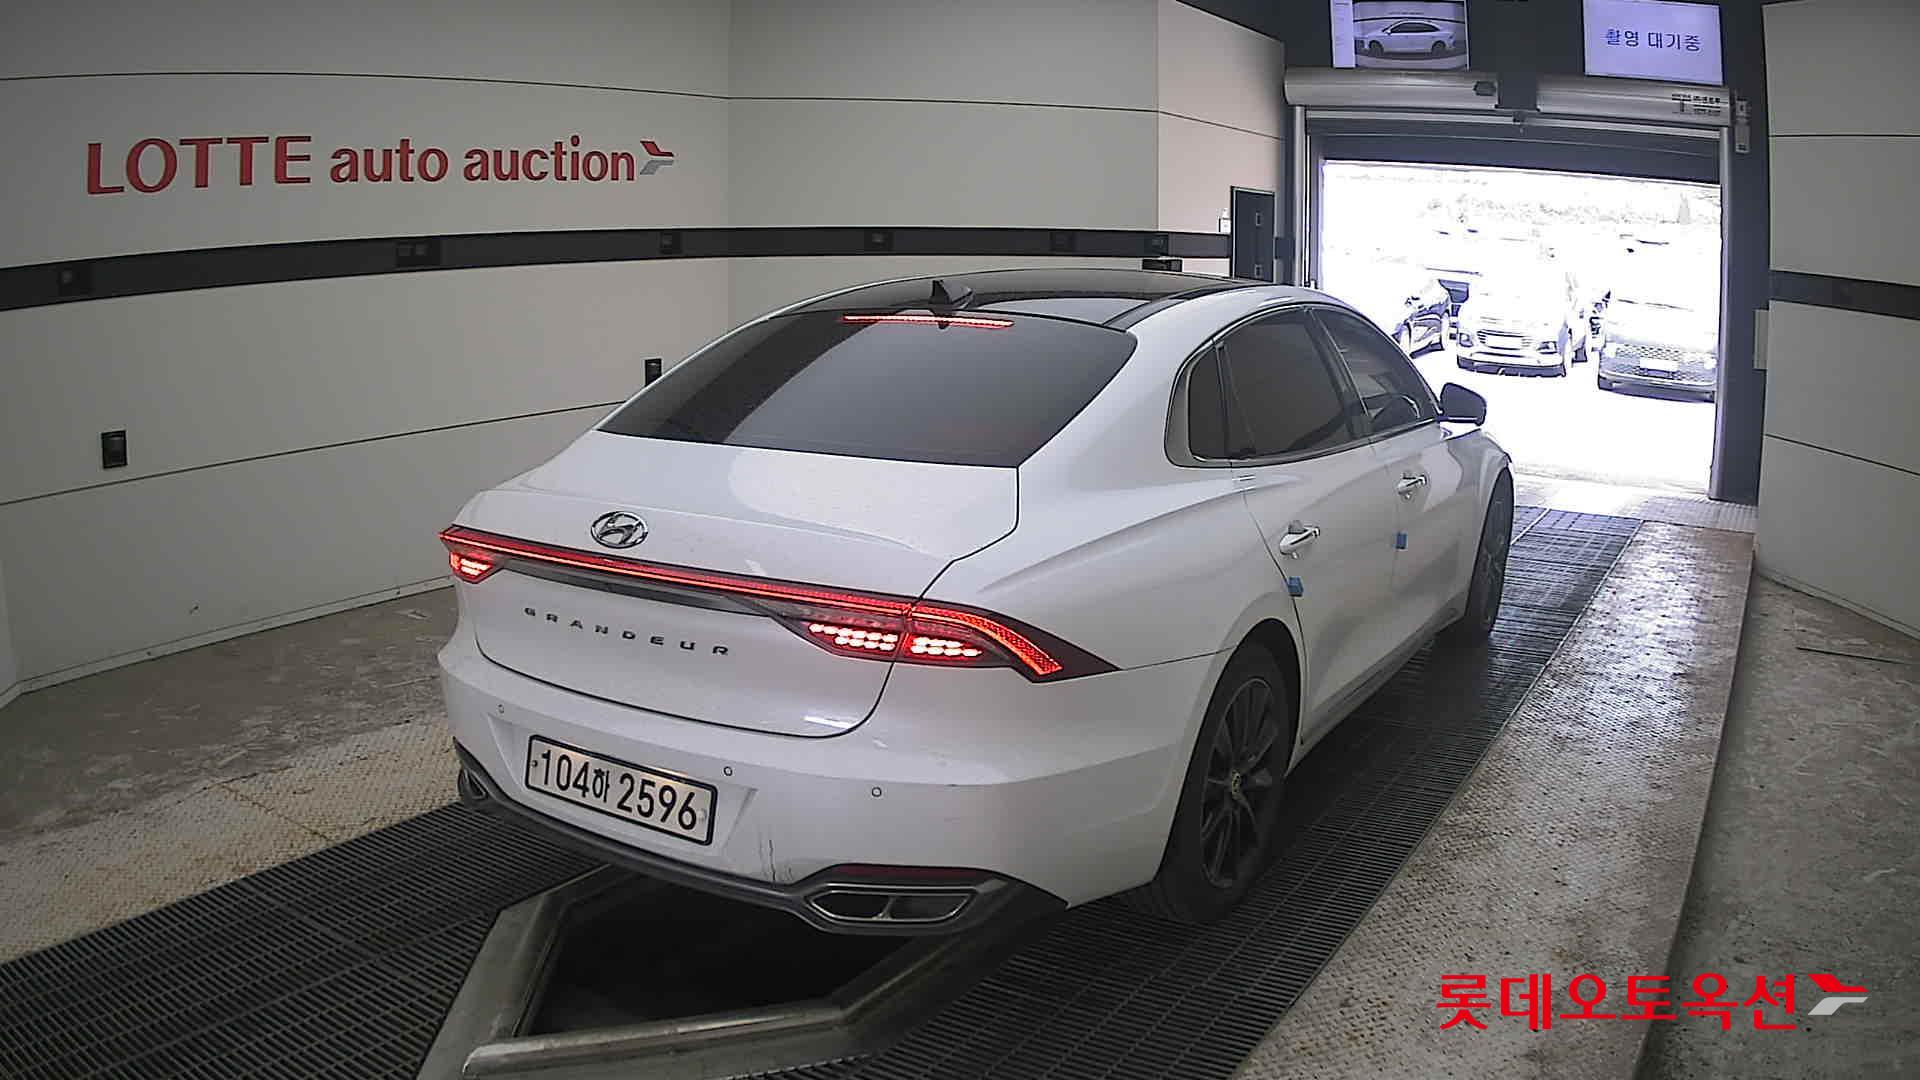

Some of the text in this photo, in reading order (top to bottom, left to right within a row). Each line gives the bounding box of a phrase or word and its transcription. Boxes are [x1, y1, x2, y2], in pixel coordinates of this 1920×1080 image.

[1647, 32, 1701, 51] 대기중
[87, 135, 635, 195] LOTTE auto auction
[524, 607, 729, 656] GRANDEUR
[541, 749, 697, 830] 104하 2596
